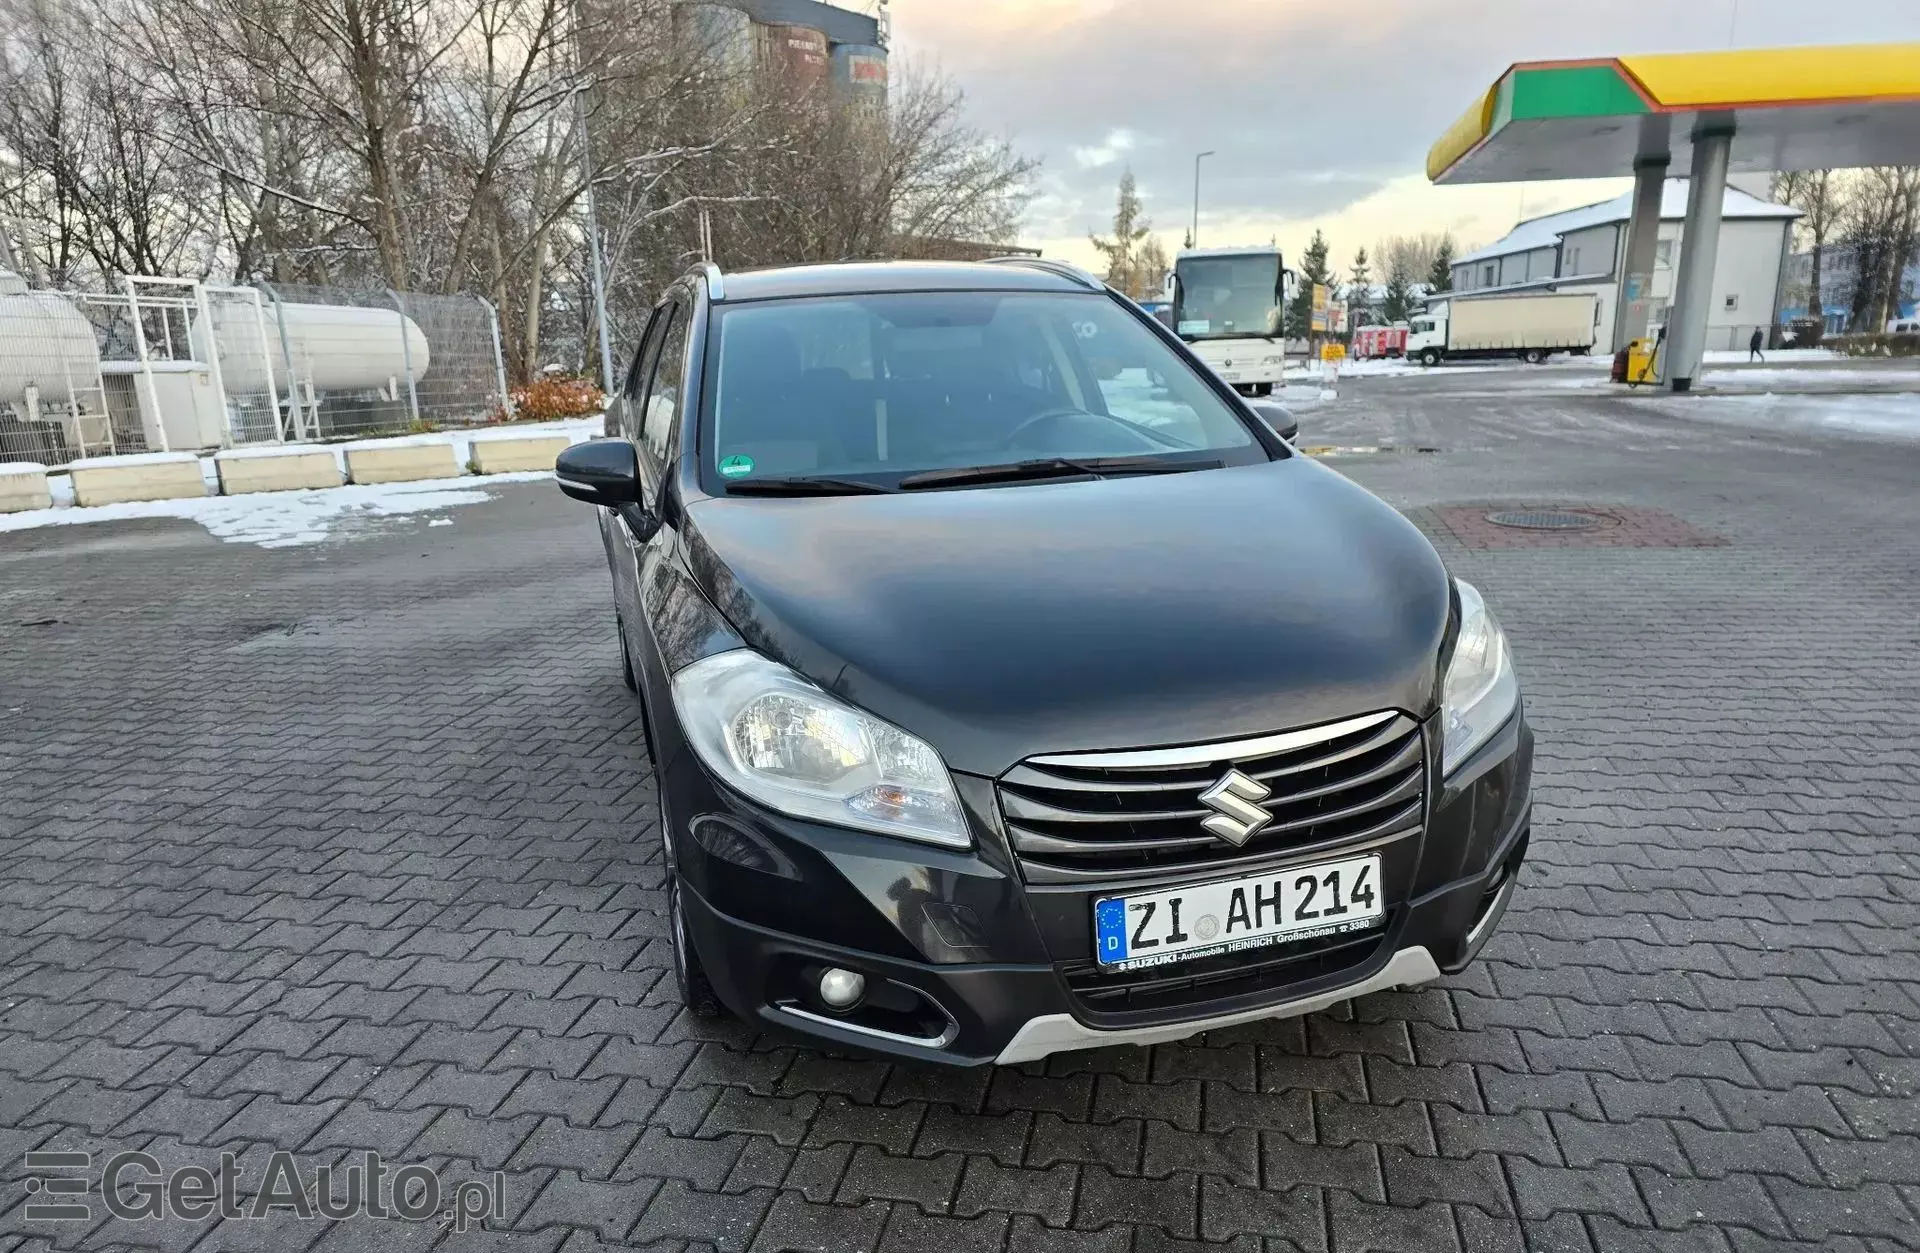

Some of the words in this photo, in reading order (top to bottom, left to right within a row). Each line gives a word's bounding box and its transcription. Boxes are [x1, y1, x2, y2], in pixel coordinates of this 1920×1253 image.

[1128, 897, 1188, 950] ZI
[1107, 936, 1119, 951] D
[1227, 936, 1273, 952] HEINRICH
[1276, 926, 1336, 943] Großschönau
